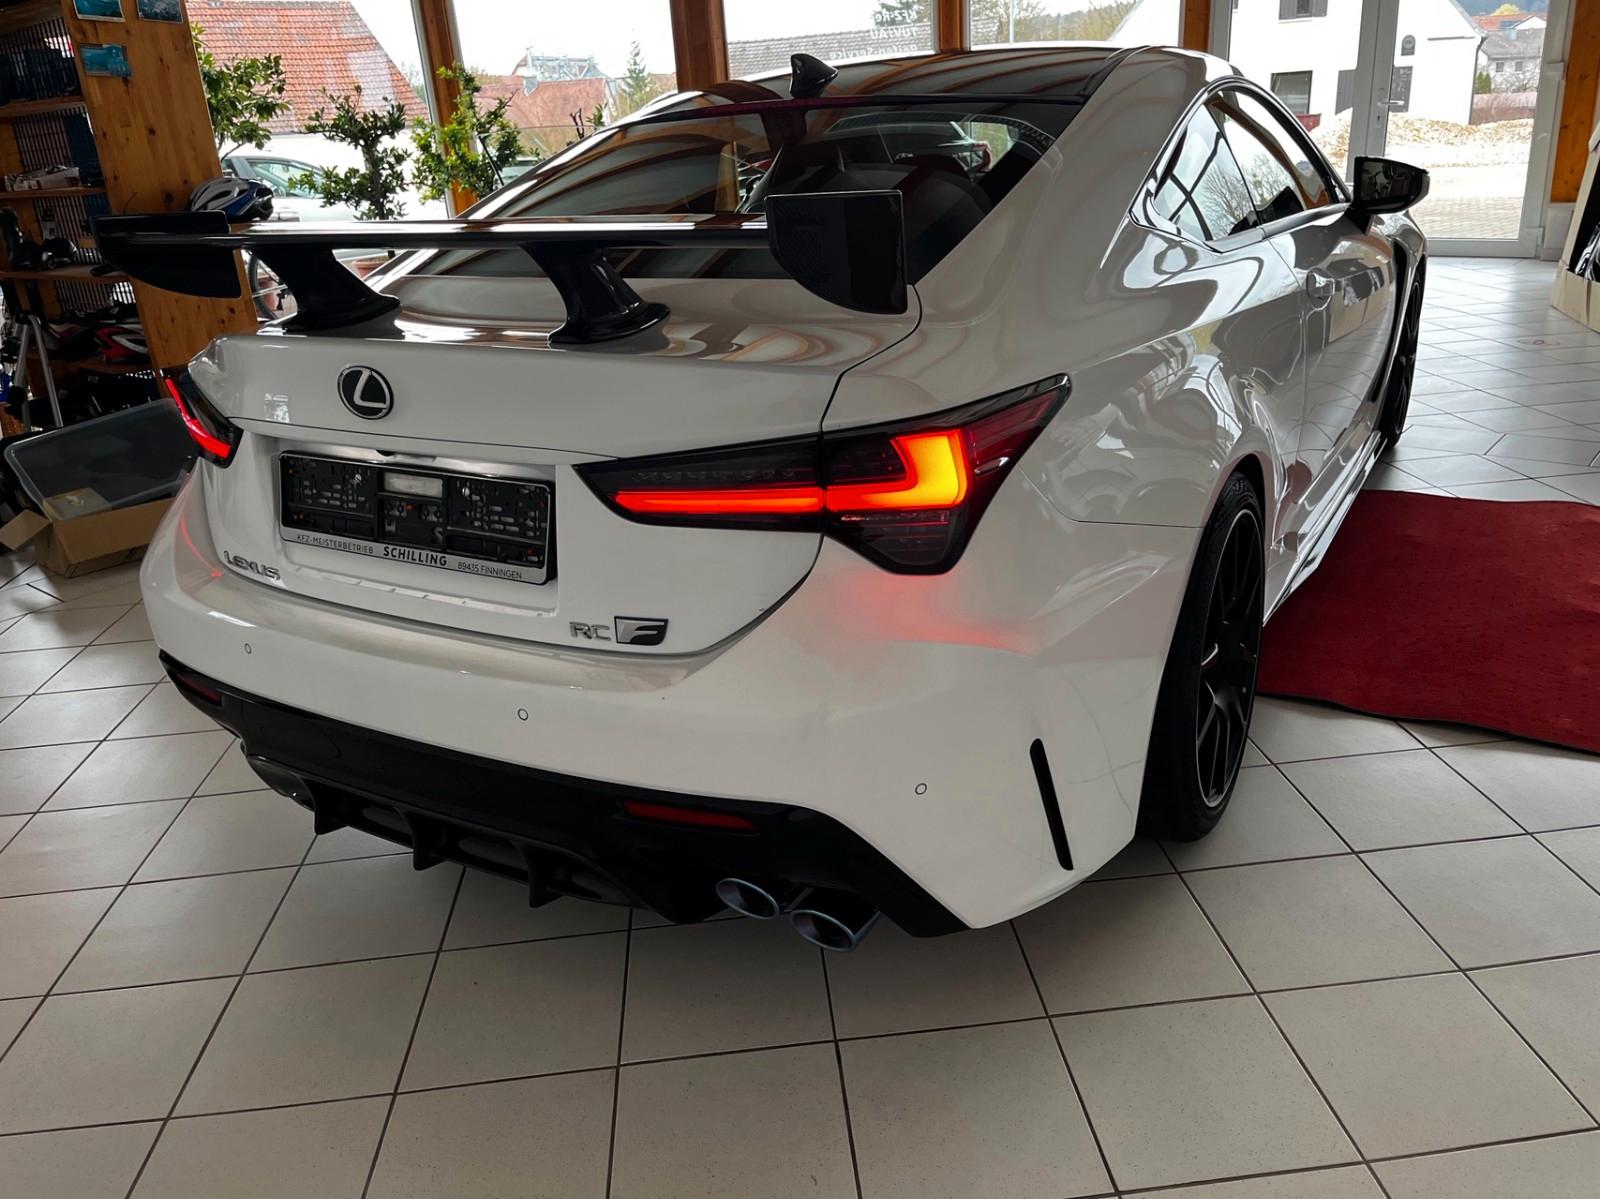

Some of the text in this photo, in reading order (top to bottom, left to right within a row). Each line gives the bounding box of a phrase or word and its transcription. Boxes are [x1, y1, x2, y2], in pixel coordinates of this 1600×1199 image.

[223, 550, 281, 581] LEXUS
[297, 533, 522, 579] KFZ-MEISTERBETRIEB SCHILLING 89435 FINNINGEN
[569, 621, 611, 642] RC
